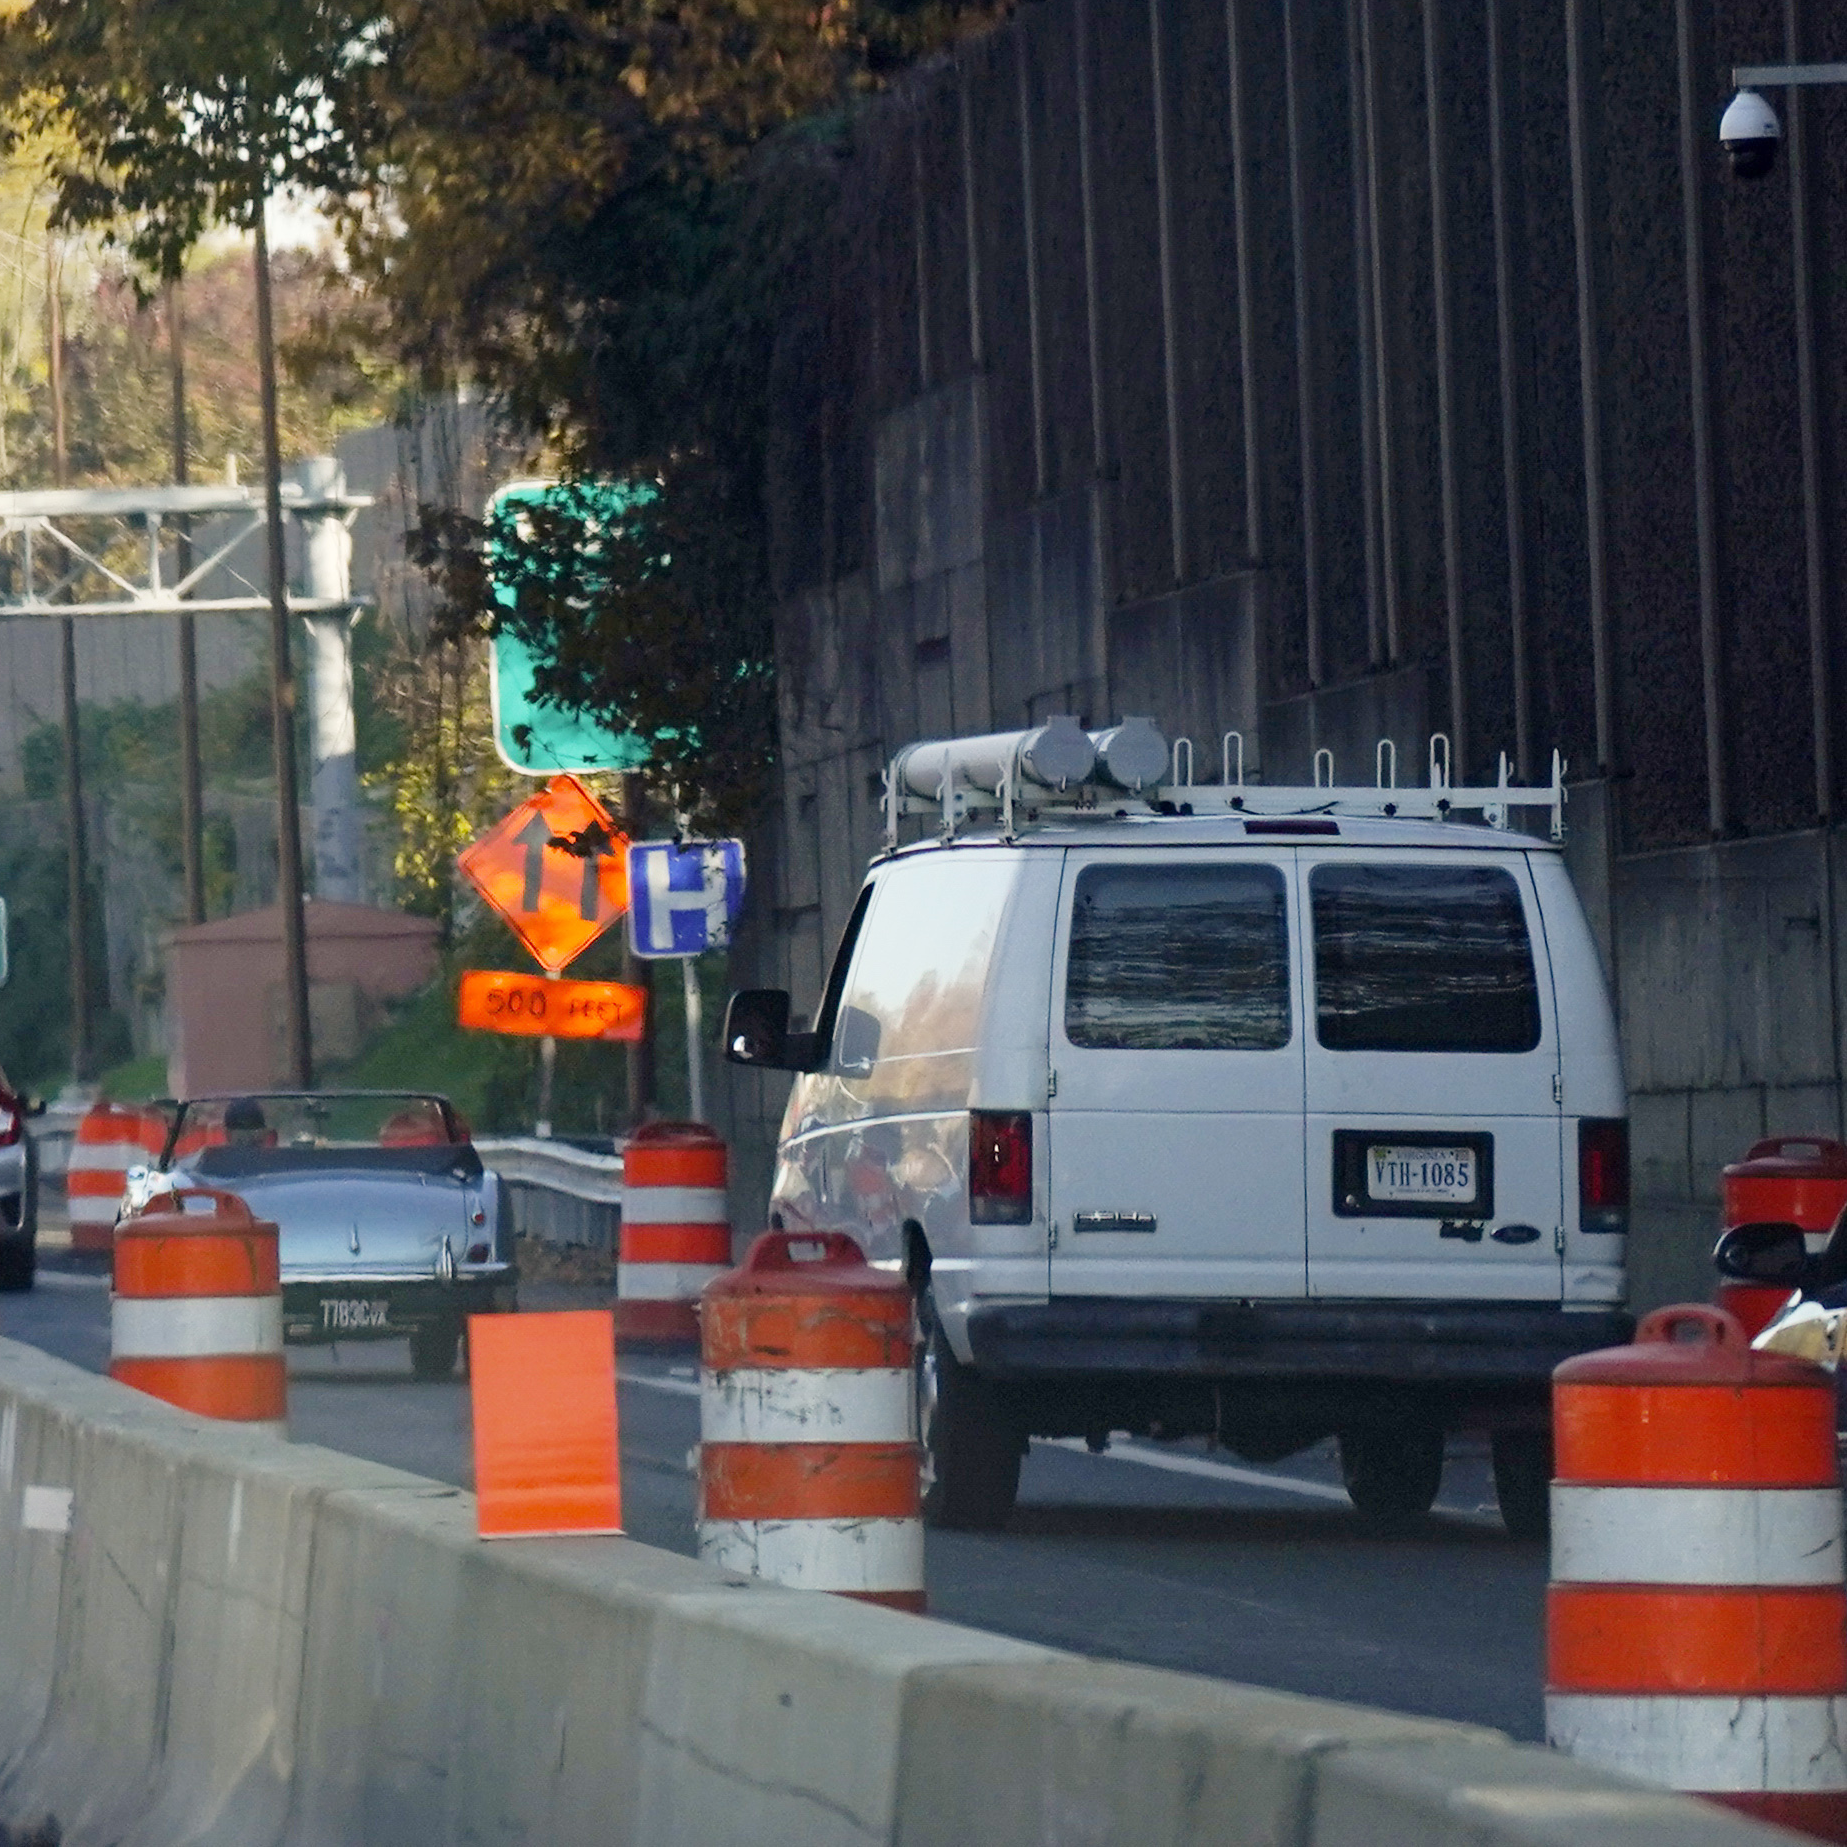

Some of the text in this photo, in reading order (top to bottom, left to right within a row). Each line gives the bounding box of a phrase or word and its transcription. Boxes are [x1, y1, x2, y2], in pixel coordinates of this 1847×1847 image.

[486, 988, 624, 1024] 500 FEET
[1375, 1162, 1469, 1188] VTH-1085
